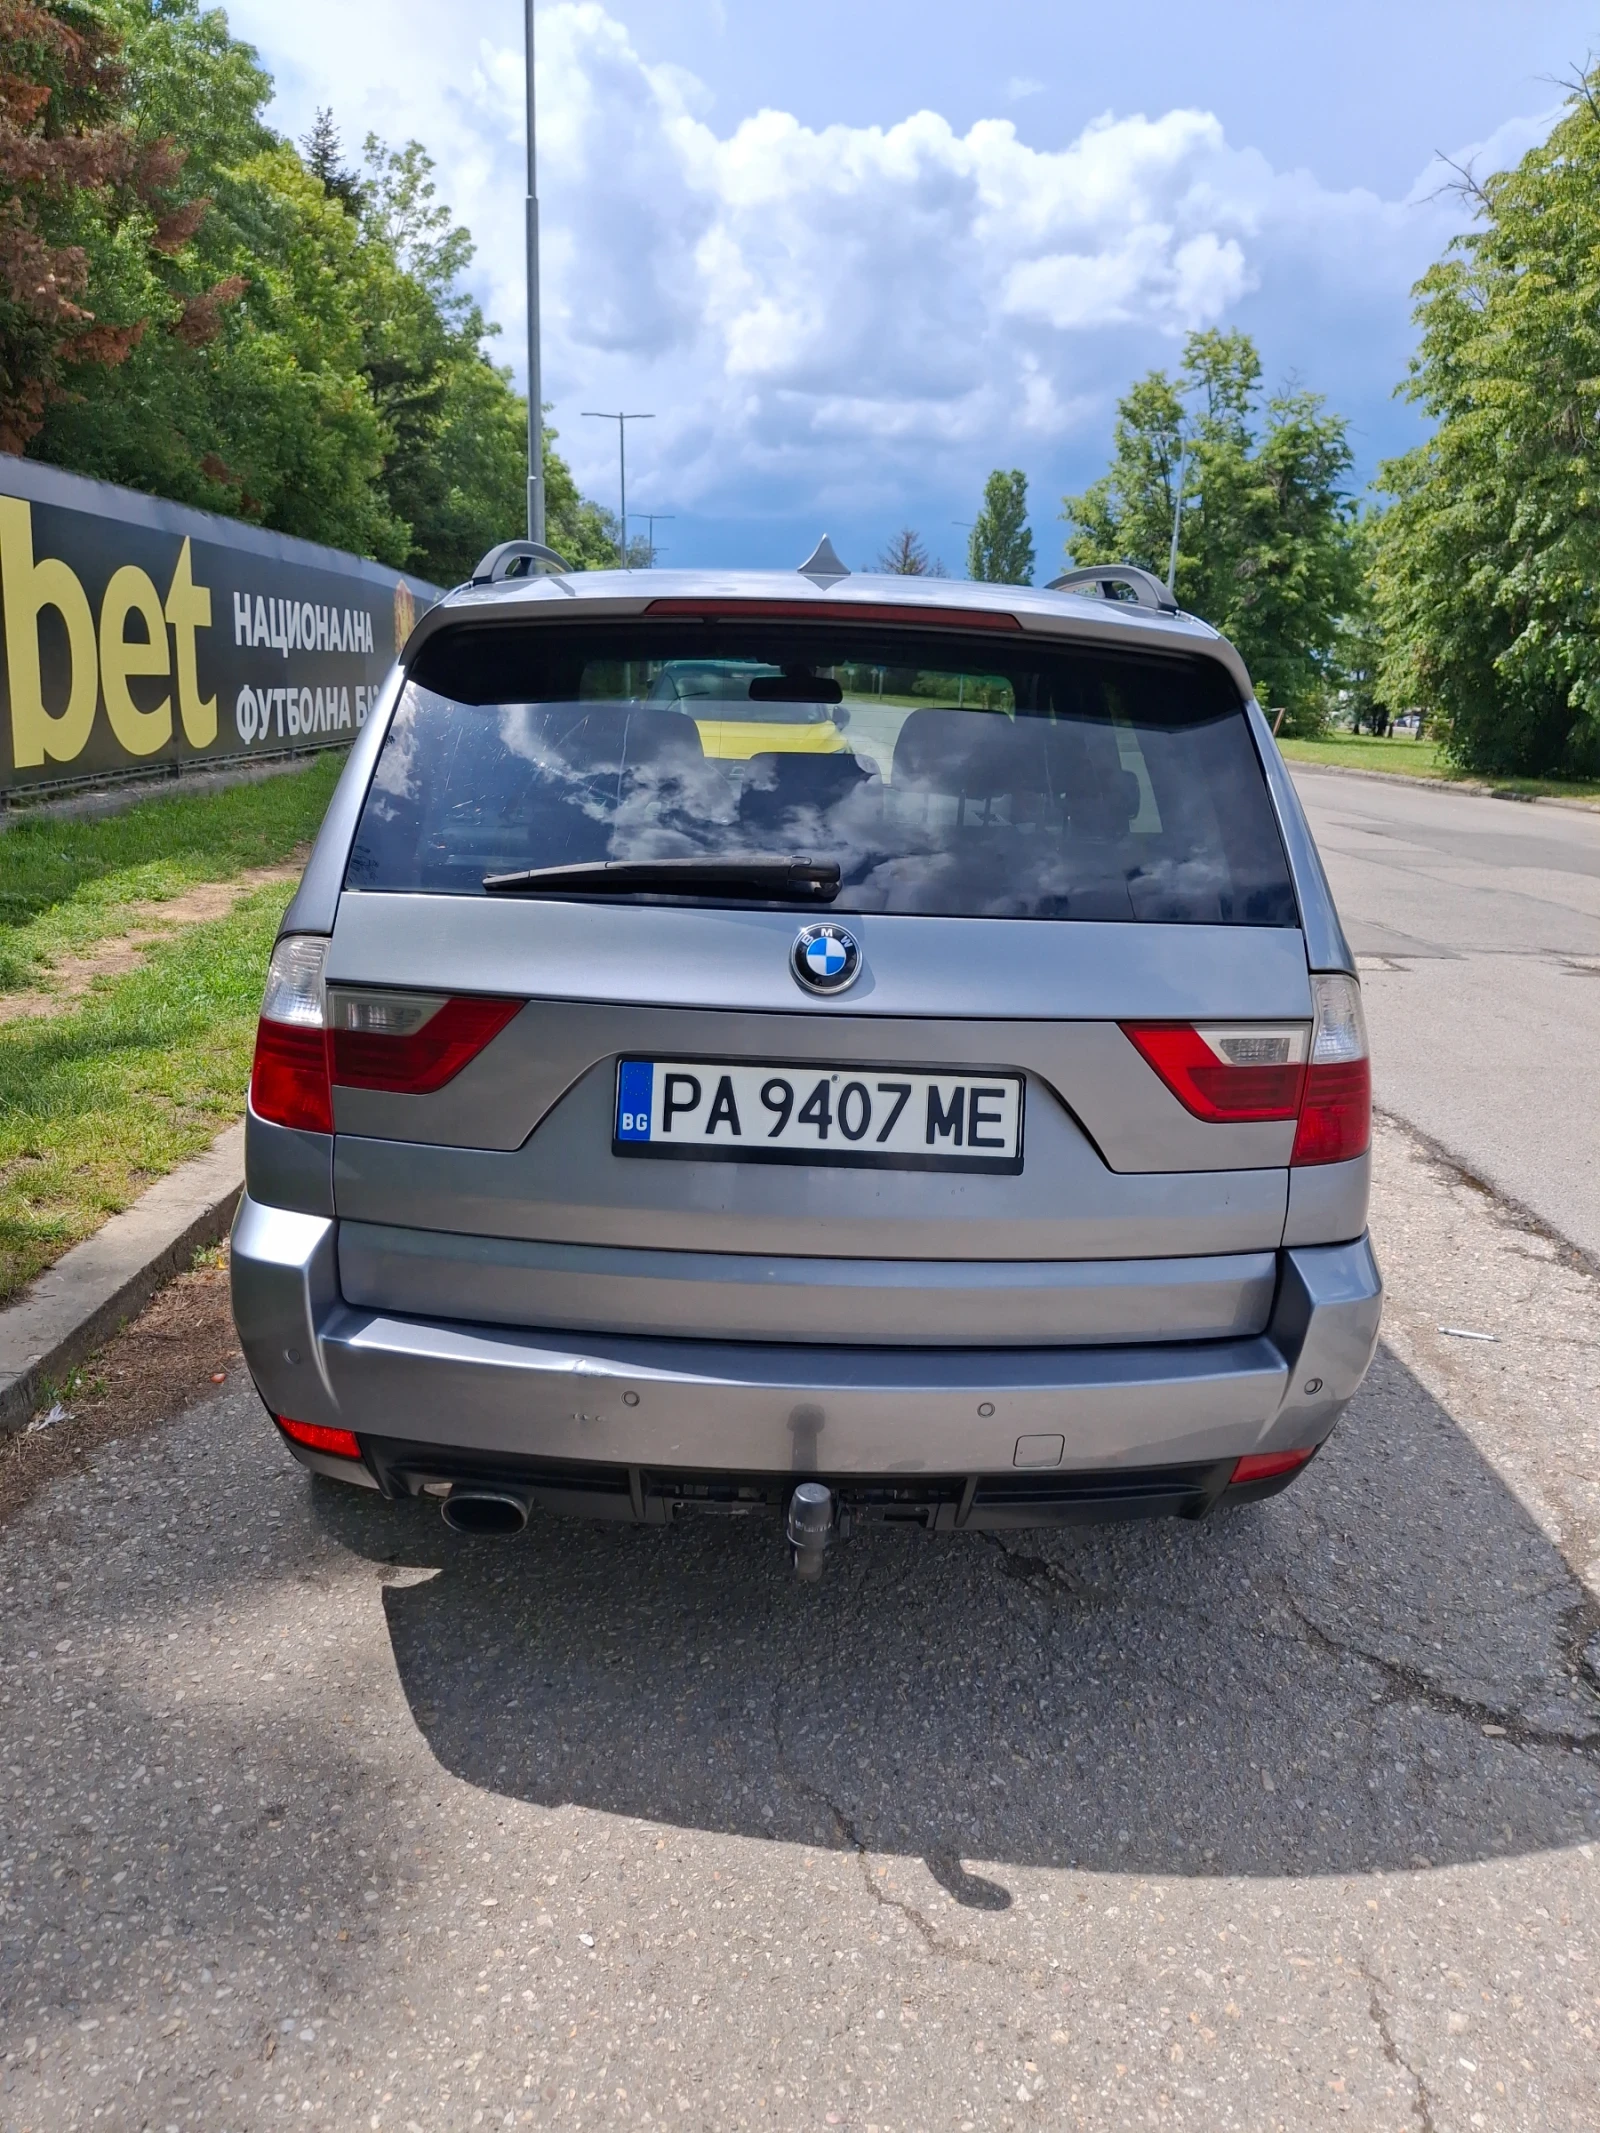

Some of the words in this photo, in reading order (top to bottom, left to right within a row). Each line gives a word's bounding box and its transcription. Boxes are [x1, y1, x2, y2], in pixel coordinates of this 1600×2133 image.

[0, 495, 217, 768] bet
[233, 591, 374, 658] НАЦИОНАЛНА
[236, 684, 351, 745] ФУТБОЛНА
[800, 928, 853, 949] BMW
[622, 1112, 648, 1131] BG
[663, 1073, 742, 1136] PA
[760, 1078, 912, 1142] 9407
[926, 1085, 1005, 1148] ME
